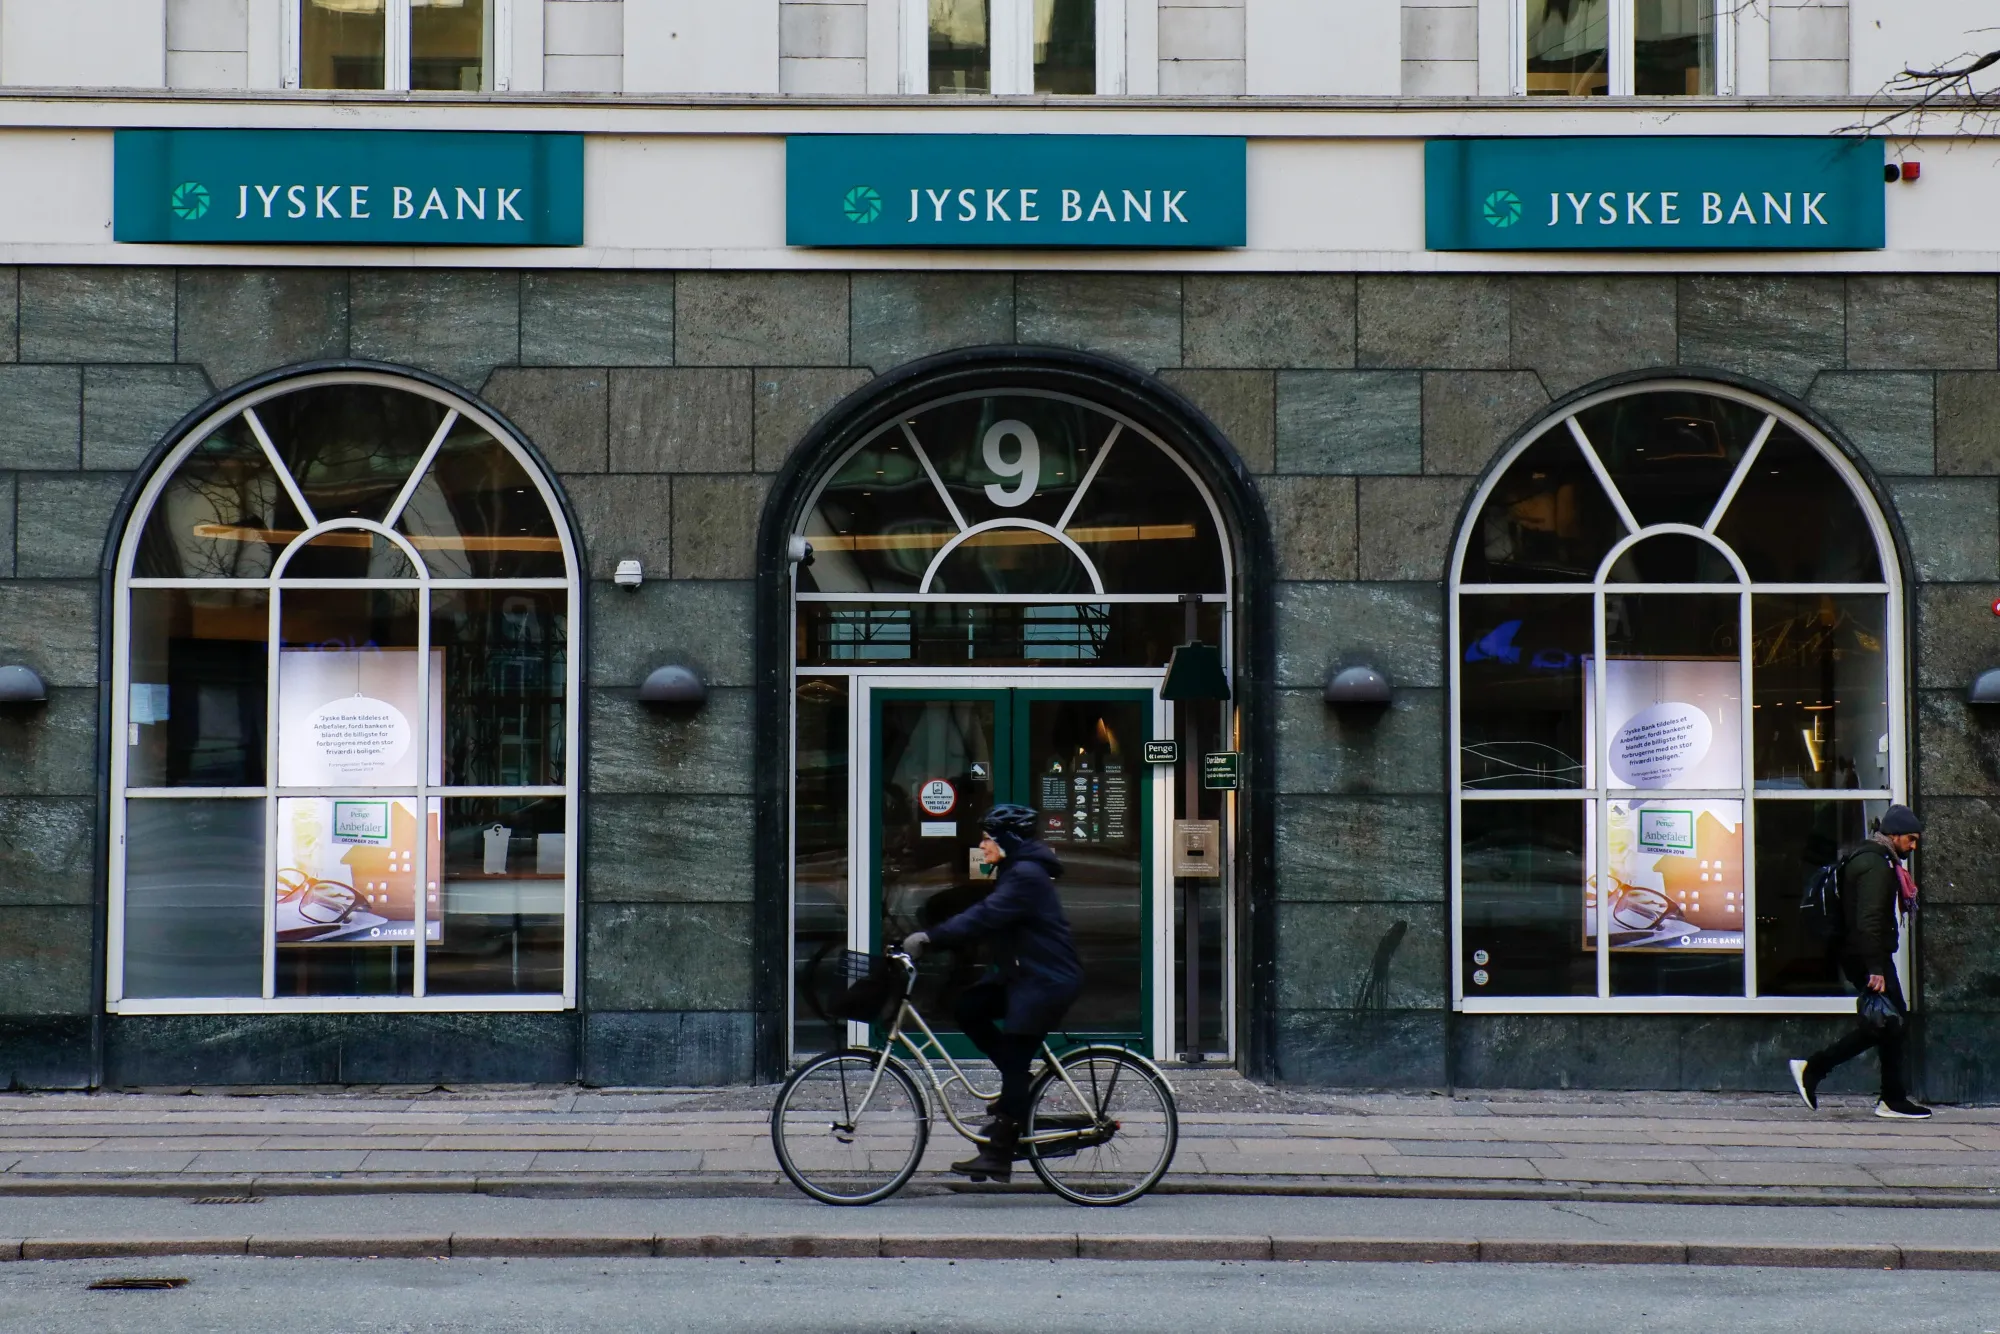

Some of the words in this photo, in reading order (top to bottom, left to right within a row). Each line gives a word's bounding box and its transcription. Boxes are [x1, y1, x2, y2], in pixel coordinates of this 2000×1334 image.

[236, 185, 371, 219] JYSKE
[393, 186, 524, 221] BANK
[907, 188, 1040, 223] JYSKE
[1061, 189, 1189, 223] BANK
[1547, 192, 1681, 226] JYSKE
[1702, 192, 1828, 225] BANK
[983, 420, 1040, 507] 9
[1657, 718, 1679, 727] tildeles
[1663, 726, 1685, 735] banken
[1652, 736, 1676, 745] billigste
[1149, 745, 1172, 753] Penge
[1622, 749, 1654, 759] forbrugerne
[340, 822, 382, 832] Anbefaler
[1645, 831, 1687, 841] Anbefaler
